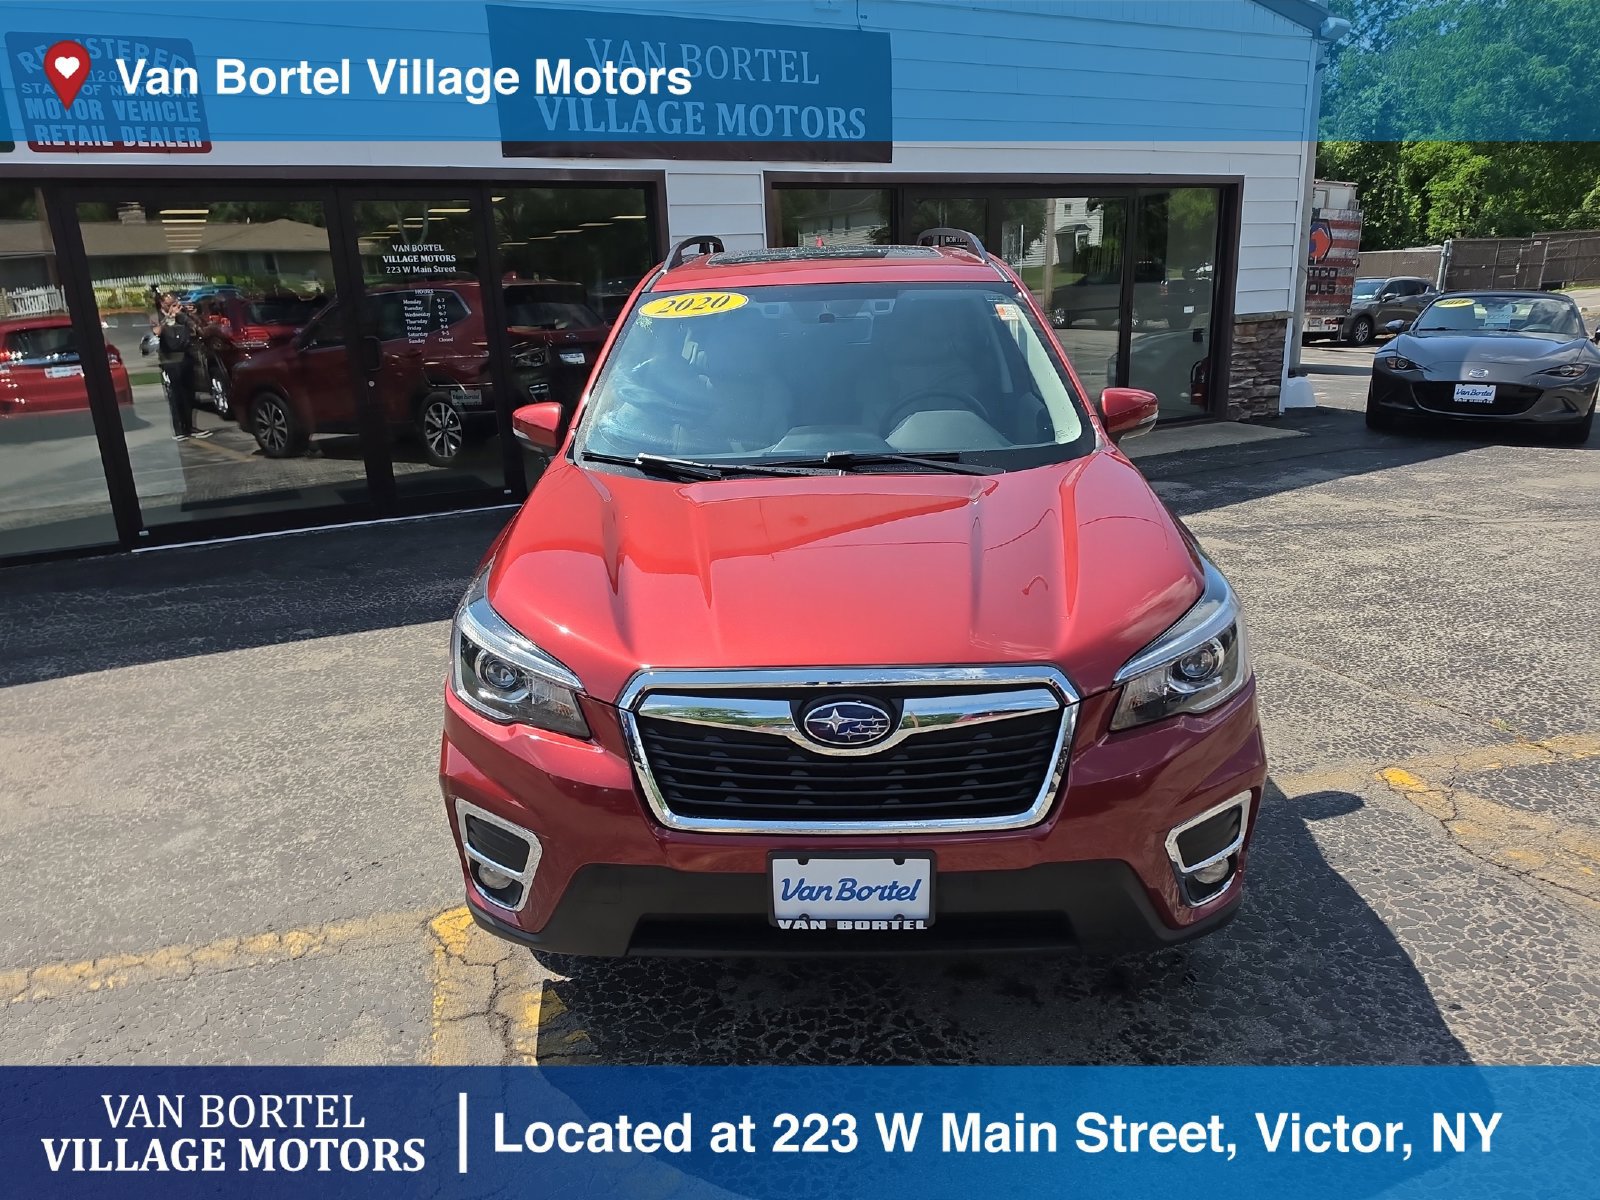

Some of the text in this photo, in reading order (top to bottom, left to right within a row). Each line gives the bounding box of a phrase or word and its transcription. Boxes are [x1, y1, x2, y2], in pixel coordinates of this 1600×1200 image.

[585, 38, 820, 85] VAN BORTEL
[22, 83, 58, 95] STA
[81, 84, 102, 95] OF
[112, 100, 201, 123] VEHICLE
[535, 95, 866, 139] VILLAGE MOTORS
[34, 125, 202, 148] RETAIL DEALER
[392, 244, 445, 252] VAN BORTEL
[382, 254, 456, 263] VILLAGE MOTORS
[385, 265, 457, 274] 223 W Main Street
[655, 295, 731, 314] 2020
[1456, 388, 1494, 397] Van Bortel
[781, 878, 922, 901] Van Bortel
[777, 920, 928, 930] VAN BORTEL
